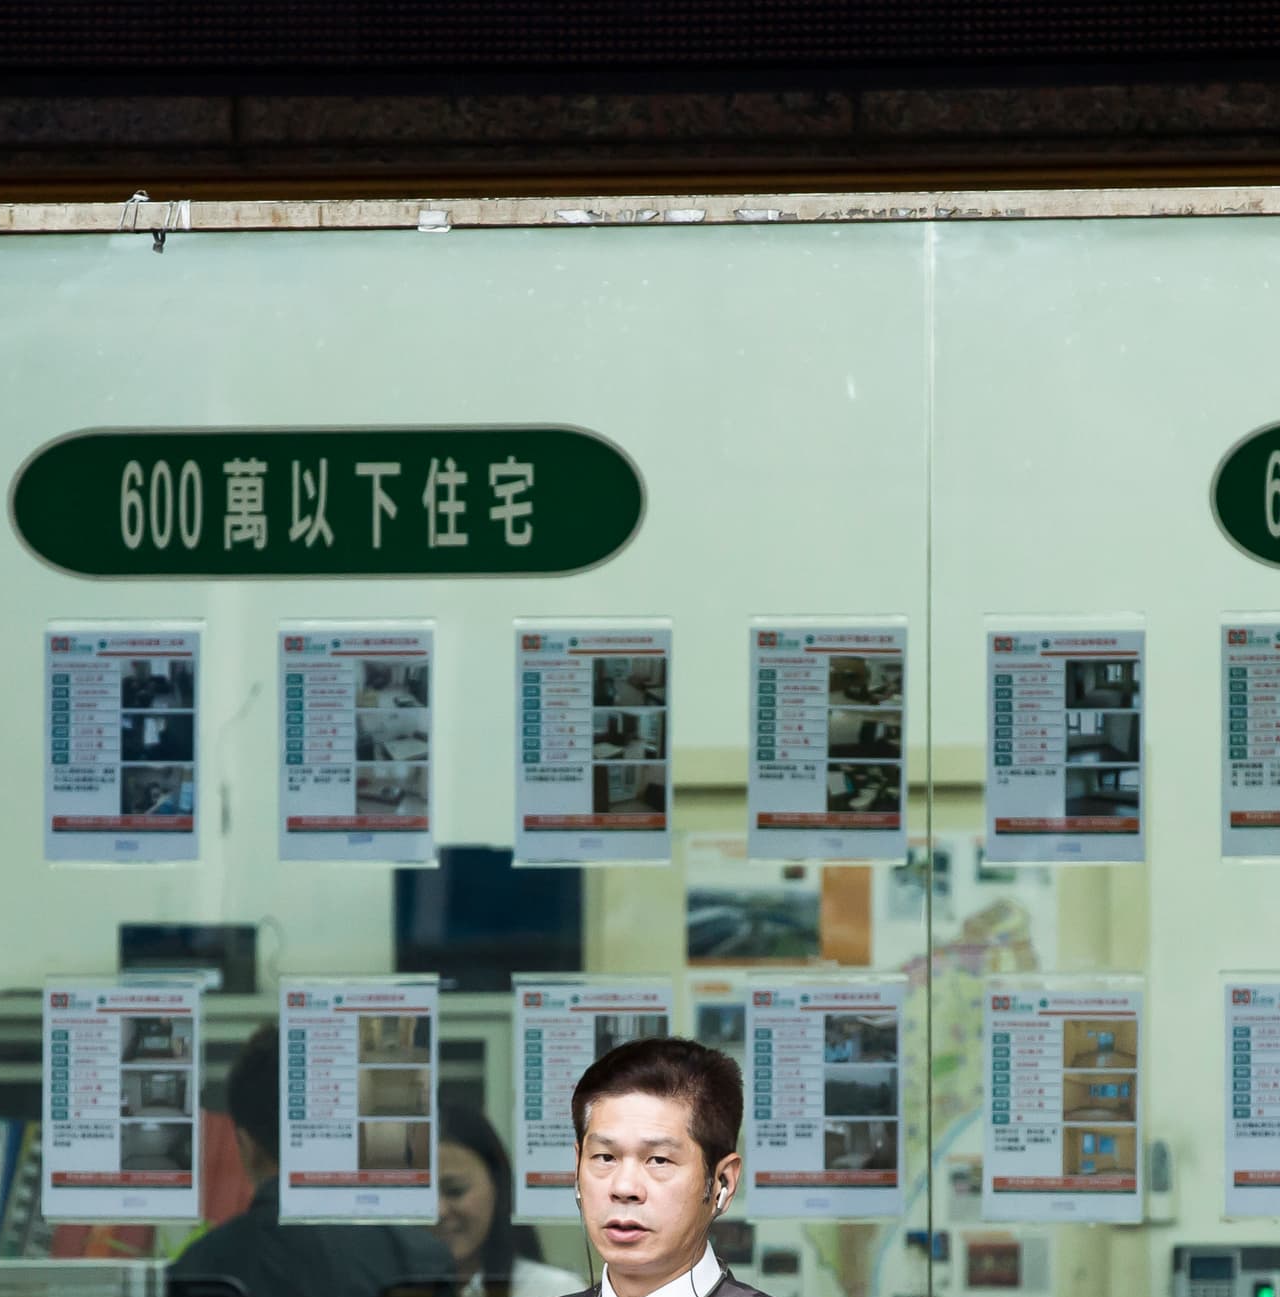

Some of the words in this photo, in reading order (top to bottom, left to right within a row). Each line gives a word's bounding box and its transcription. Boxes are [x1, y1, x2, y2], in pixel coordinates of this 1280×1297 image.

[120, 456, 535, 550] 600萬以下住宅
